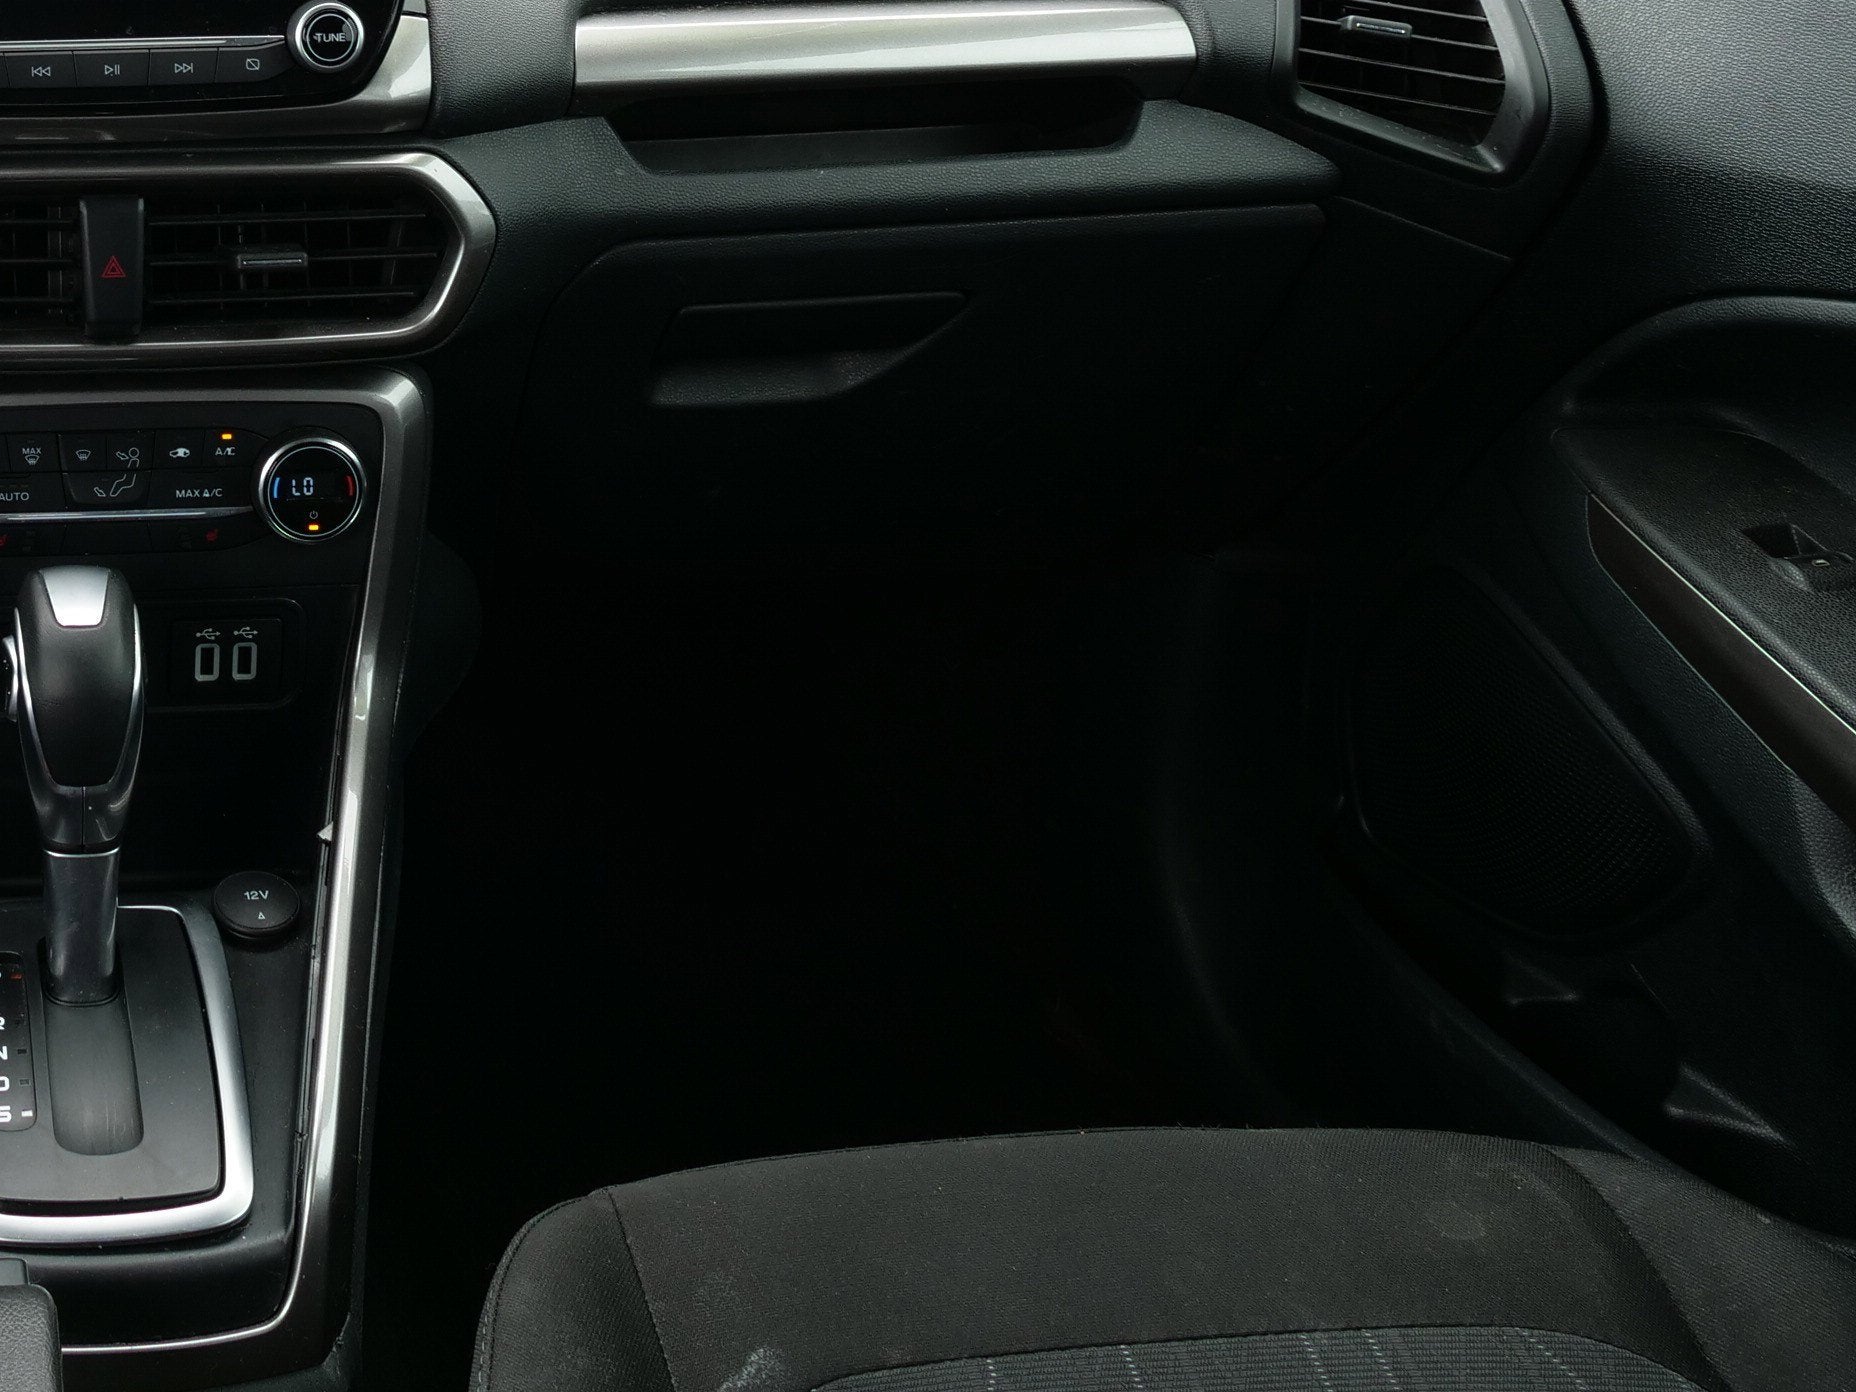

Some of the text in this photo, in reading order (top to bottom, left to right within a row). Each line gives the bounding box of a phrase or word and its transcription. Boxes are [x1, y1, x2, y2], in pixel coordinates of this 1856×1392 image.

[315, 32, 347, 44] TUNE
[21, 447, 42, 455] MAX
[215, 446, 236, 456] A/C
[291, 477, 314, 496] LO
[175, 488, 223, 498] MAX A/C
[243, 889, 270, 901] 12V
